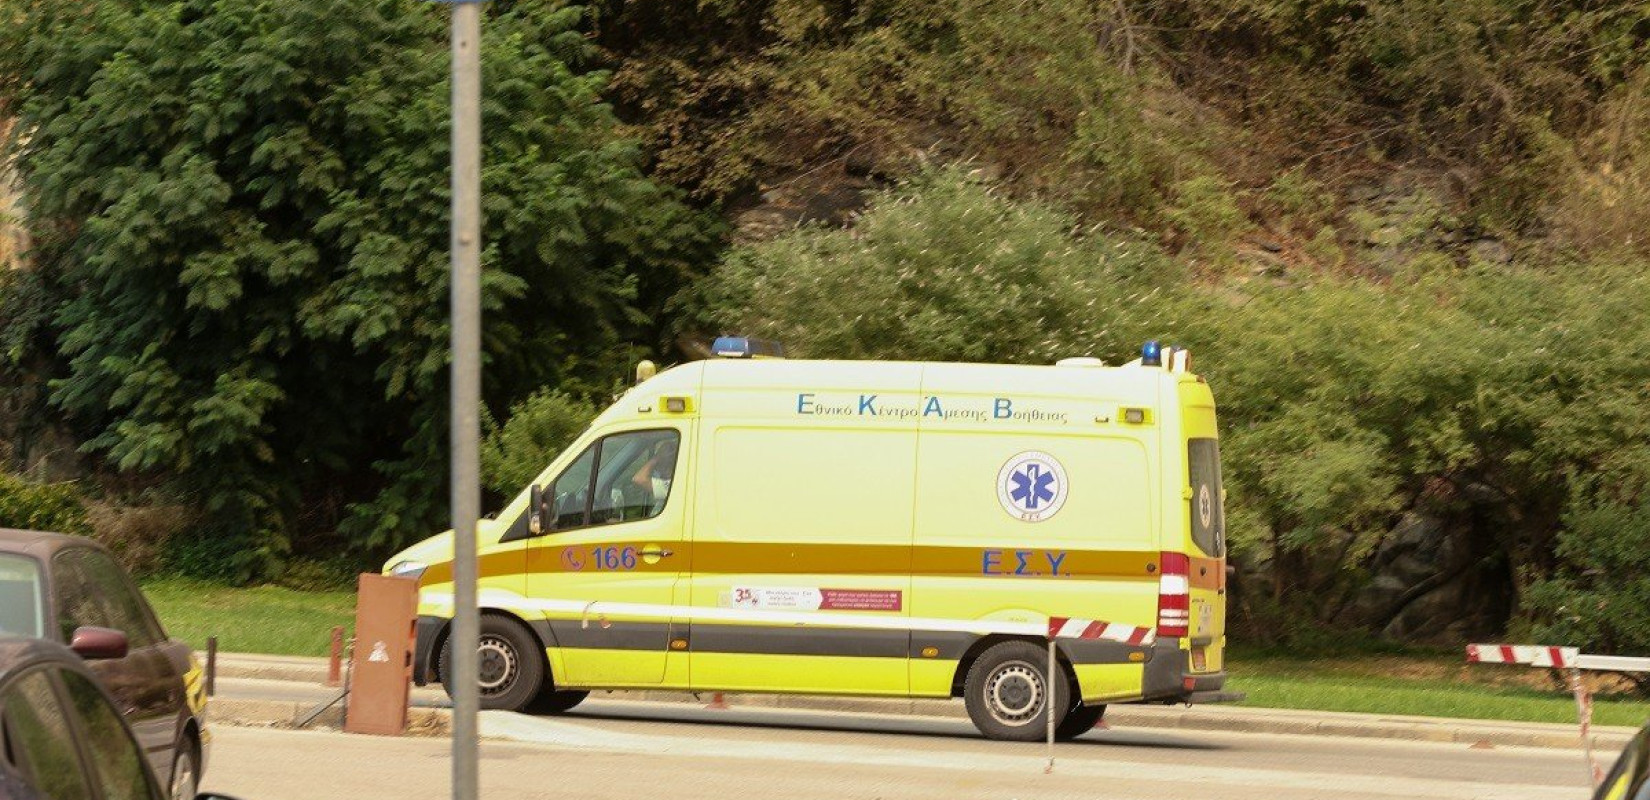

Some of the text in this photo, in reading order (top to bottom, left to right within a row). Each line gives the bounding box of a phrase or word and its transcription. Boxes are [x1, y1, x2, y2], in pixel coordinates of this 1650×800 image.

[797, 393, 1068, 424] Εθνικό Κέντρο Άμεσης Βοήθειας
[591, 546, 637, 570] 166
[982, 550, 1071, 577] Ε.Σ.Υ.
